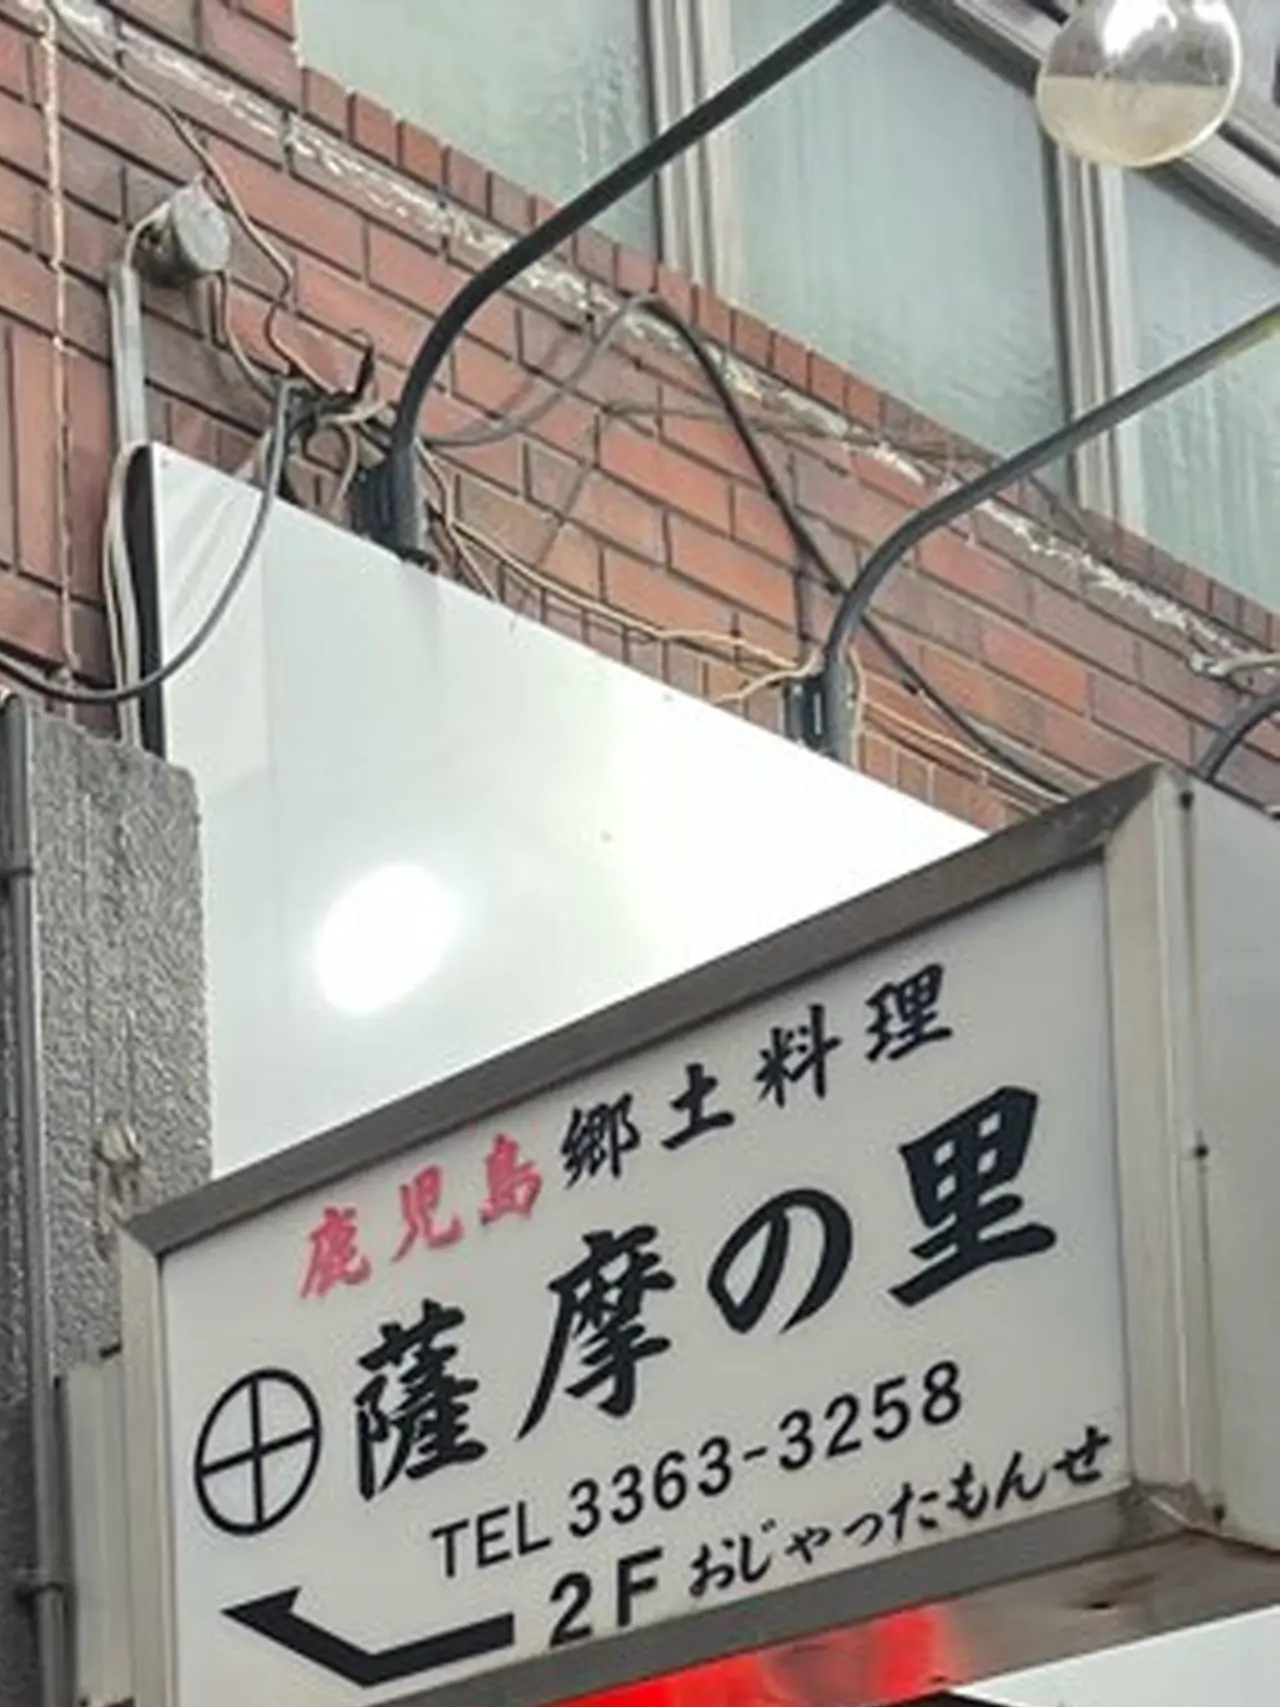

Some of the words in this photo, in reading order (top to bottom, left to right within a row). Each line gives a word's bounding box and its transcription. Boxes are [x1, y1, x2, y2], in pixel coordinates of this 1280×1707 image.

[354, 1085, 1057, 1501] 薩摩の里
[432, 1506, 551, 1578] TEL
[568, 1360, 963, 1538] 3363-3258
[550, 1546, 663, 1647] 2F
[689, 1425, 1114, 1598] おじゃったもんせ
